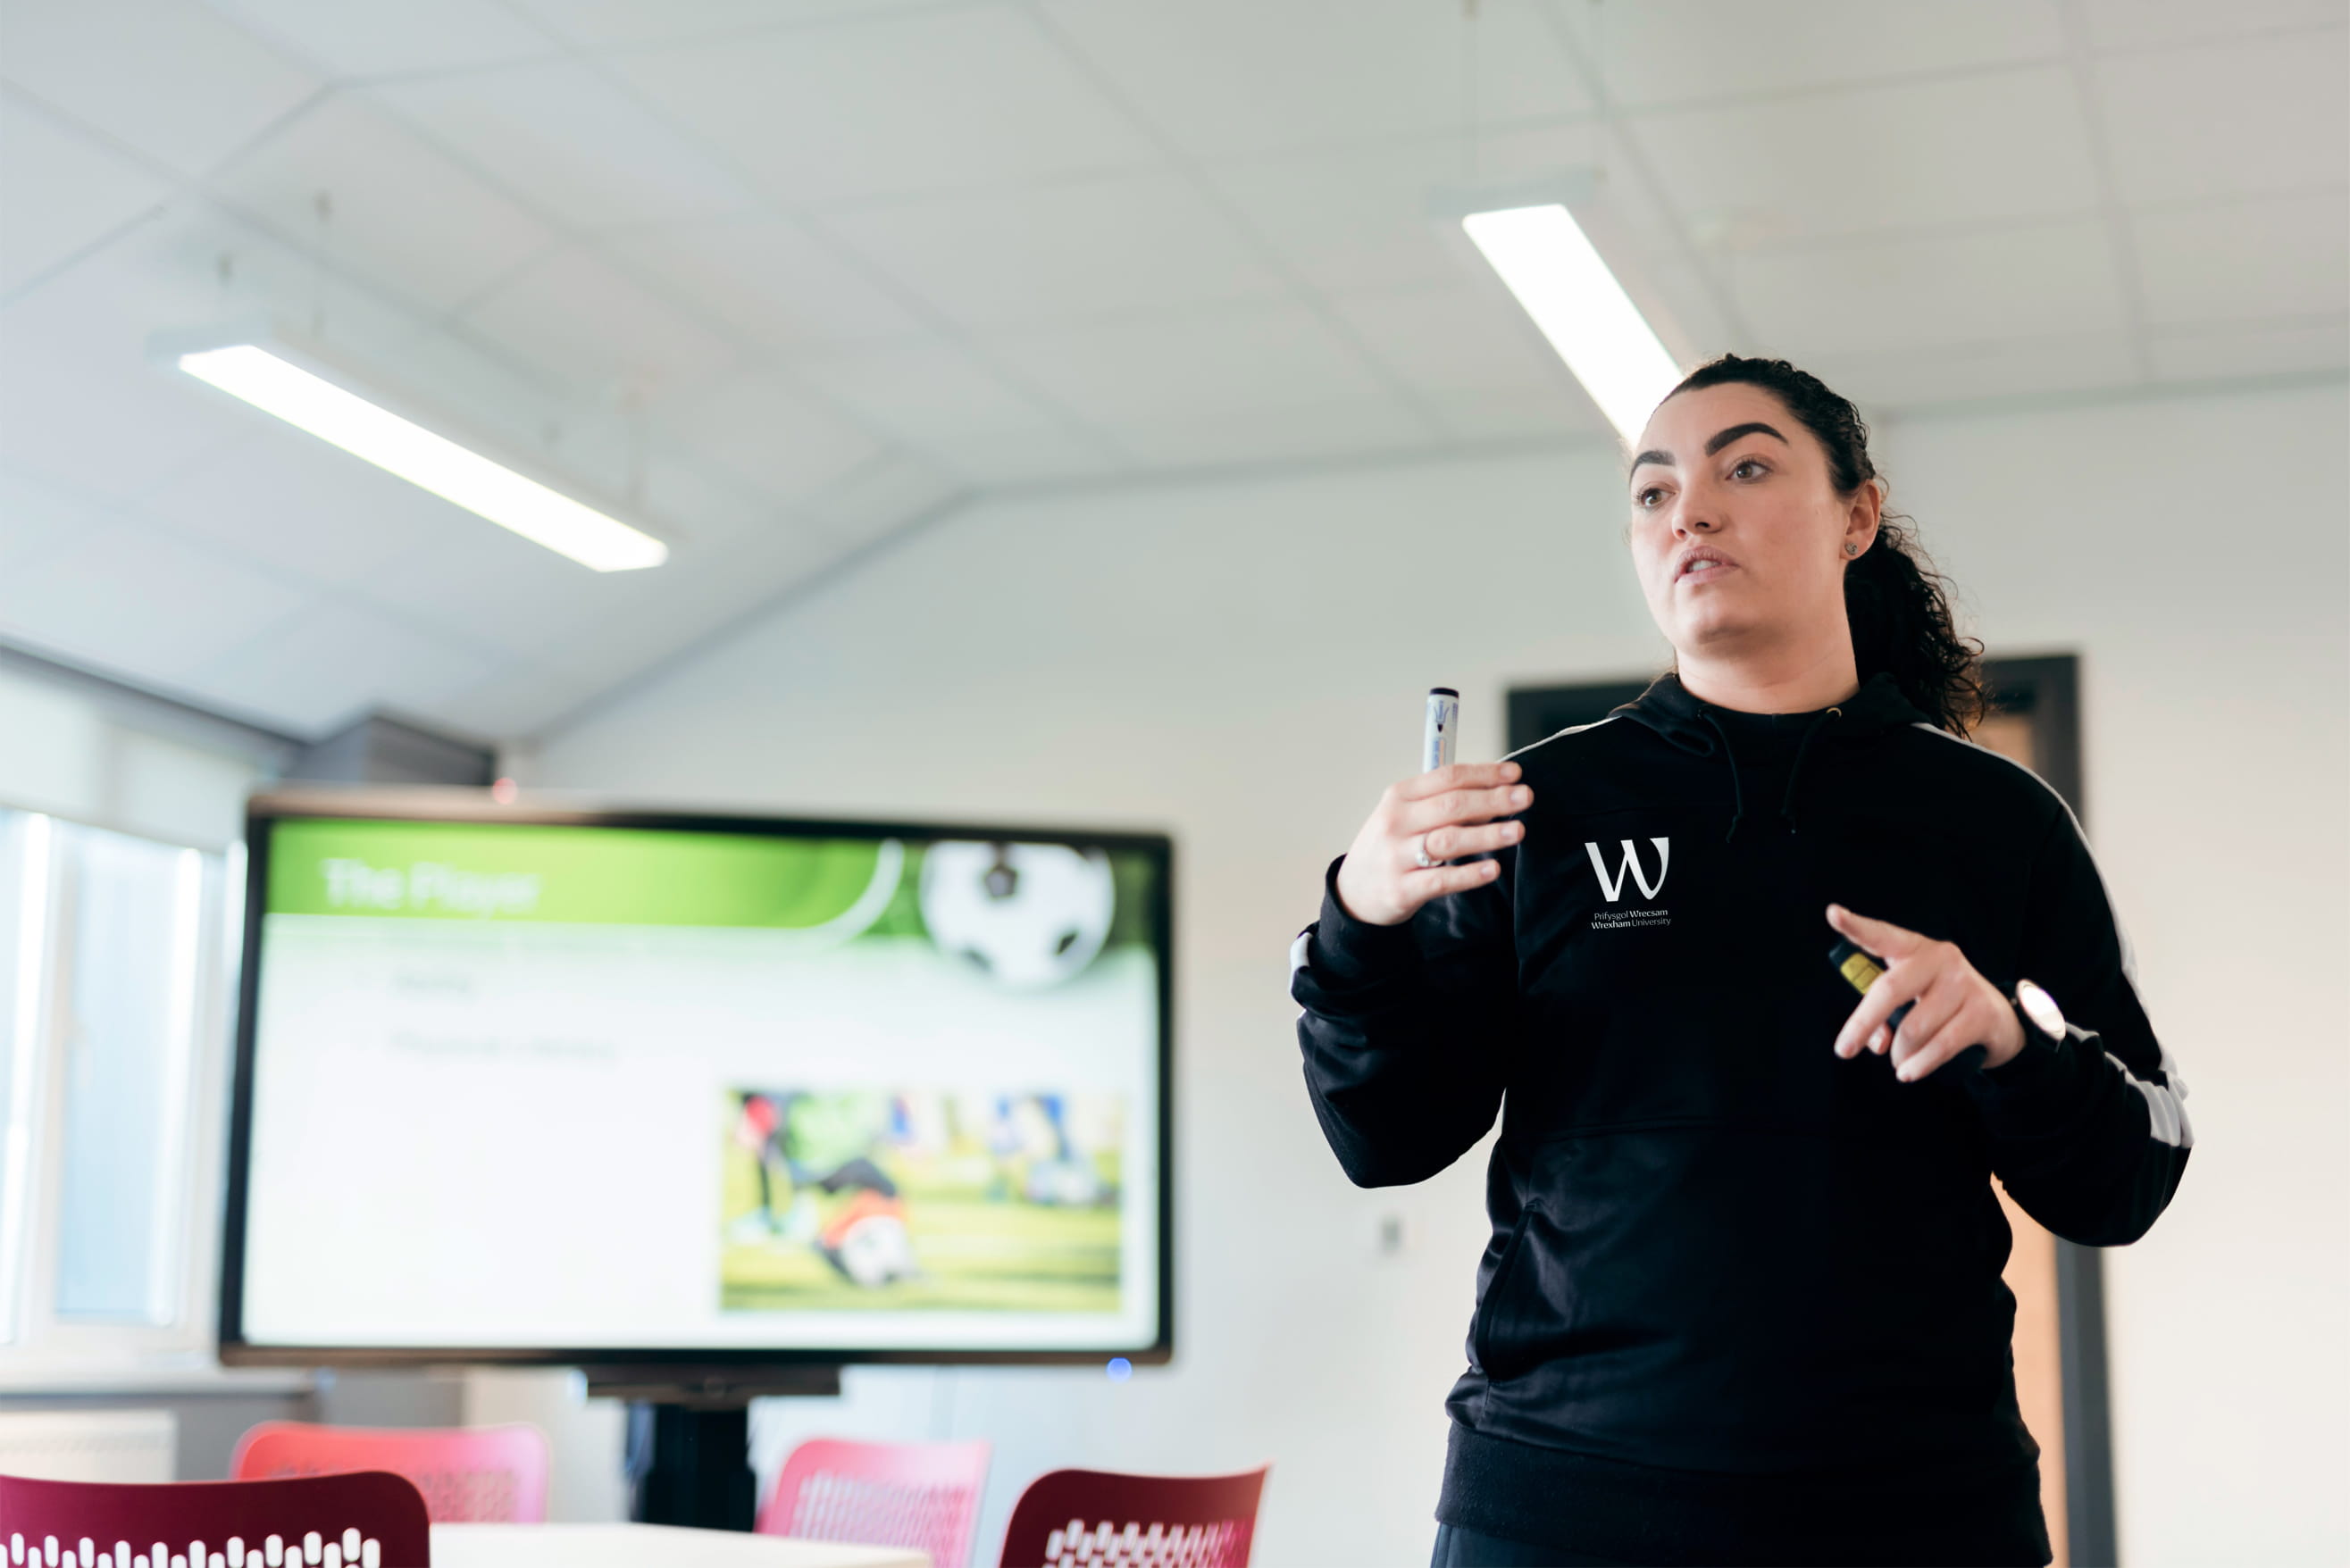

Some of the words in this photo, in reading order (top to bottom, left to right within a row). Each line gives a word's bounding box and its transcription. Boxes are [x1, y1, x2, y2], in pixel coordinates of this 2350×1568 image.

[322, 857, 405, 909] The
[410, 862, 541, 920] Player
[1585, 837, 1669, 902] W
[1591, 921, 1631, 930] Wrexham
[1631, 917, 1671, 927] University
[1594, 911, 1628, 921] Prifysgol
[1629, 909, 1668, 918] Wrecsam
